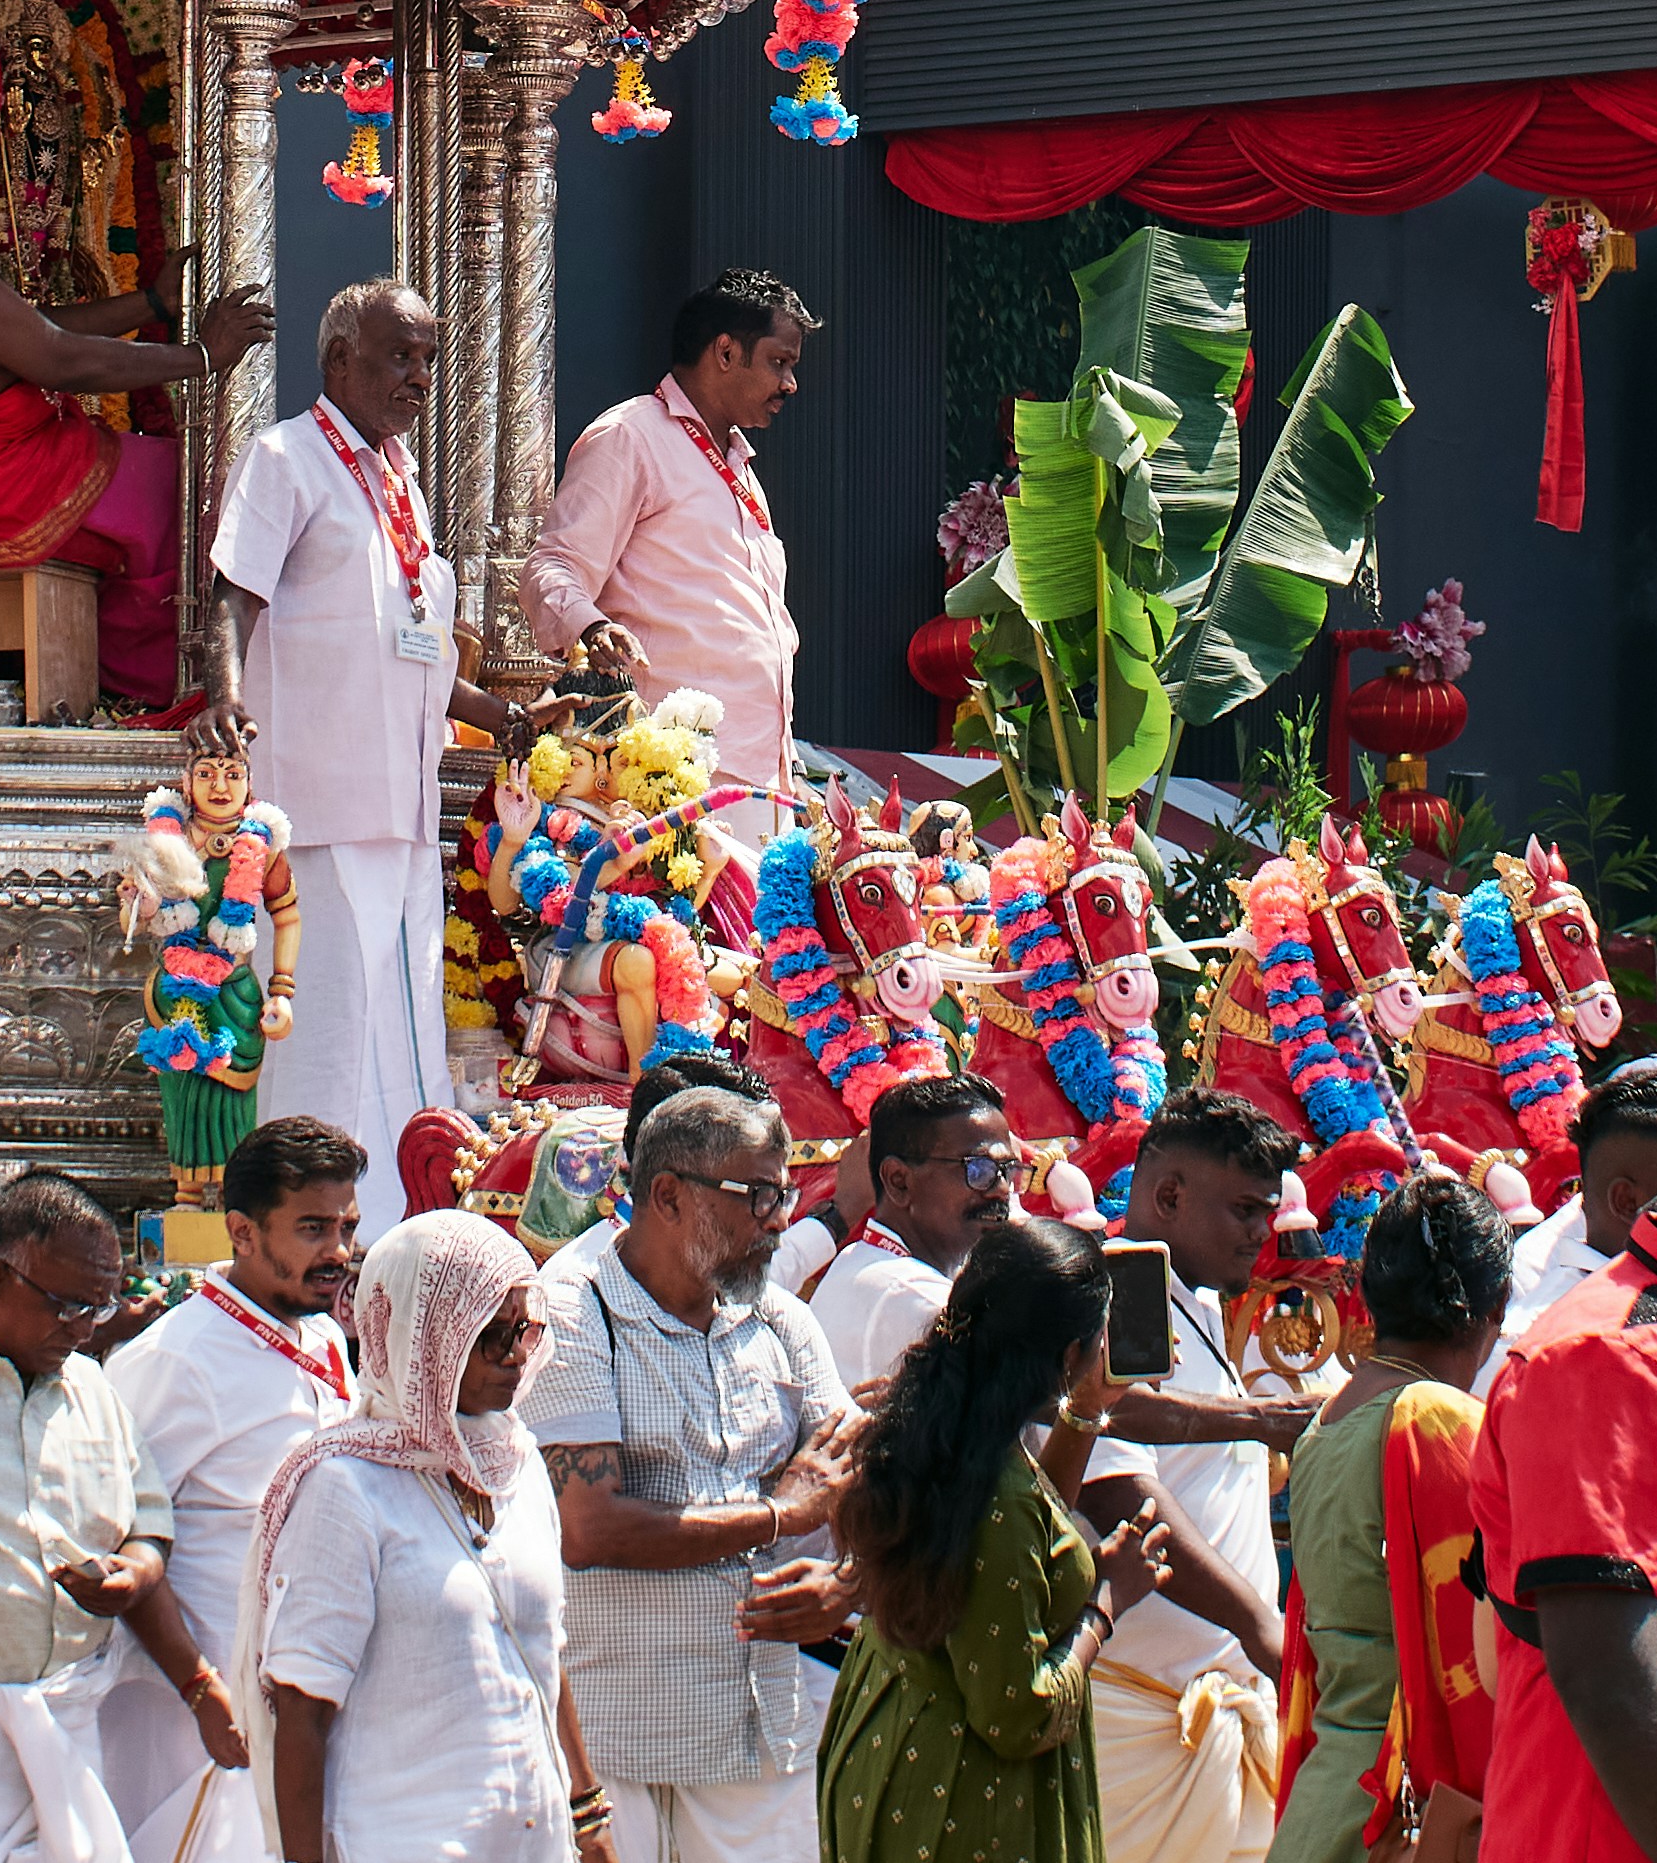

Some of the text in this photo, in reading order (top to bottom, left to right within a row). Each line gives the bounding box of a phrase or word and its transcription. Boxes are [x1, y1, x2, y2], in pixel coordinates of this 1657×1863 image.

[324, 429, 346, 452] PNTT
[684, 421, 702, 440] NTT
[705, 447, 728, 472] PNTT
[730, 479, 753, 504] PNTT
[551, 1092, 604, 1106] Golden 50
[213, 1292, 245, 1319] PNTT
[254, 1322, 287, 1349] PNTT
